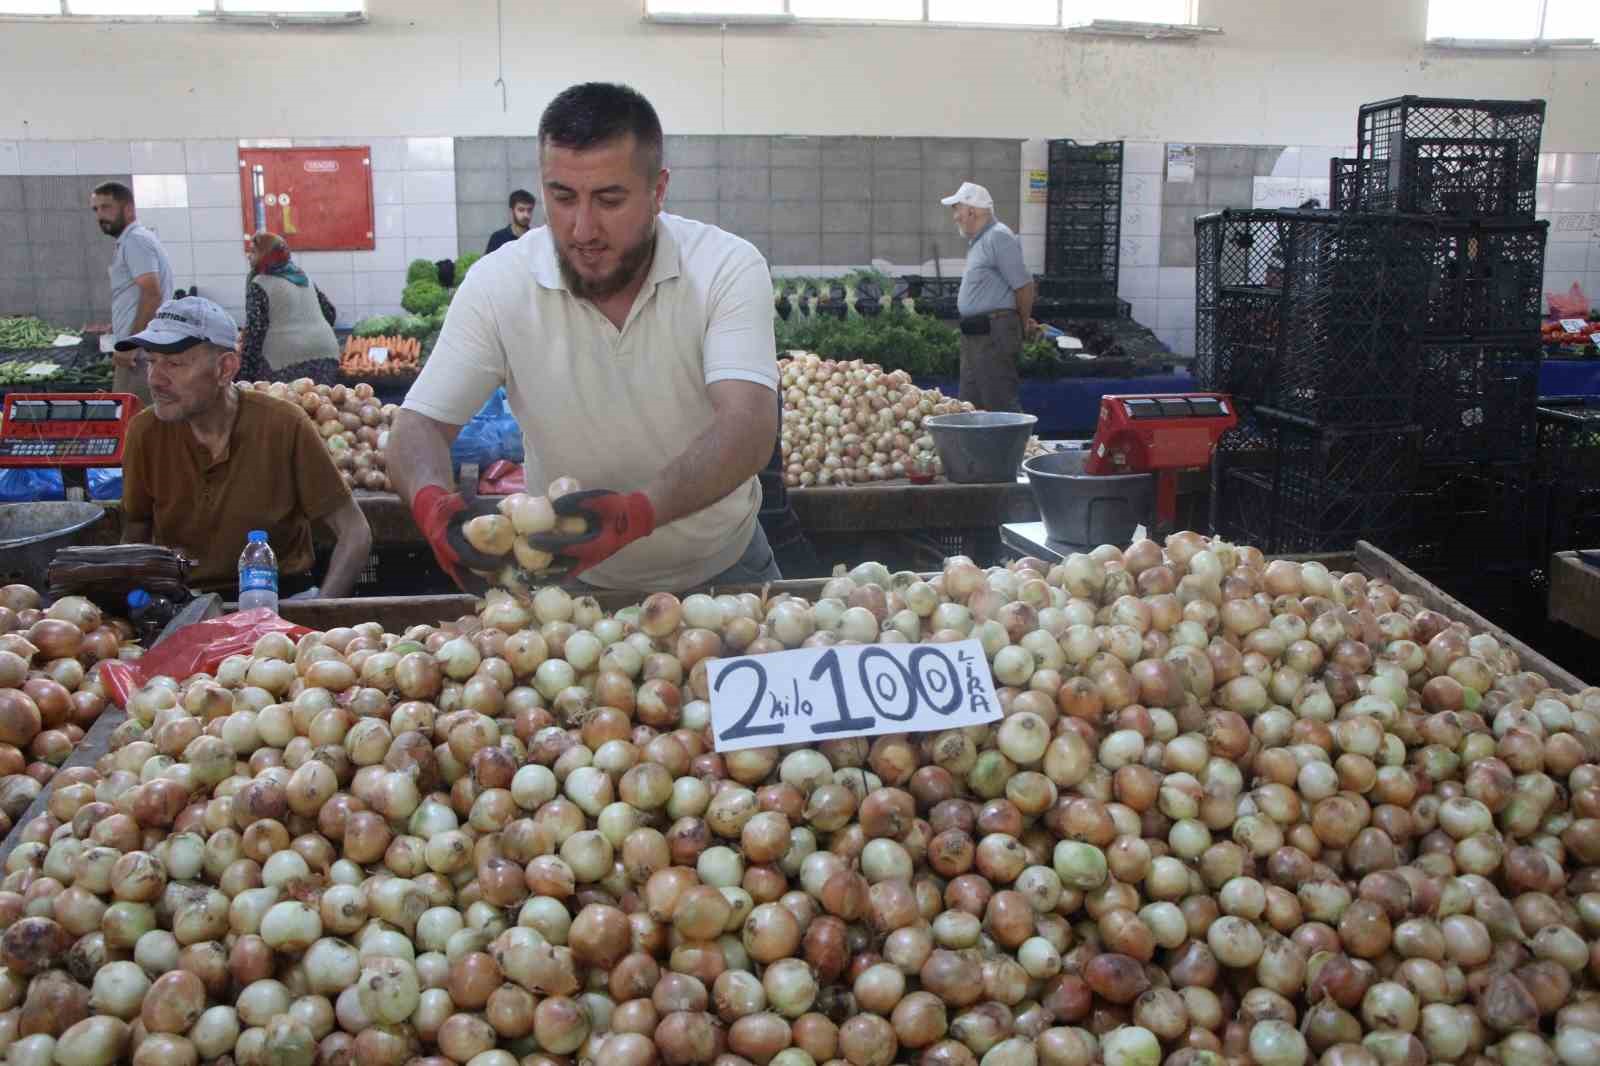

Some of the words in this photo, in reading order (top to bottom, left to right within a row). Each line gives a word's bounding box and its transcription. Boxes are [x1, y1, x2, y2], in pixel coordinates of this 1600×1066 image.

[714, 659, 785, 741] 2
[769, 678, 813, 719] kilo
[809, 647, 964, 734] 100
